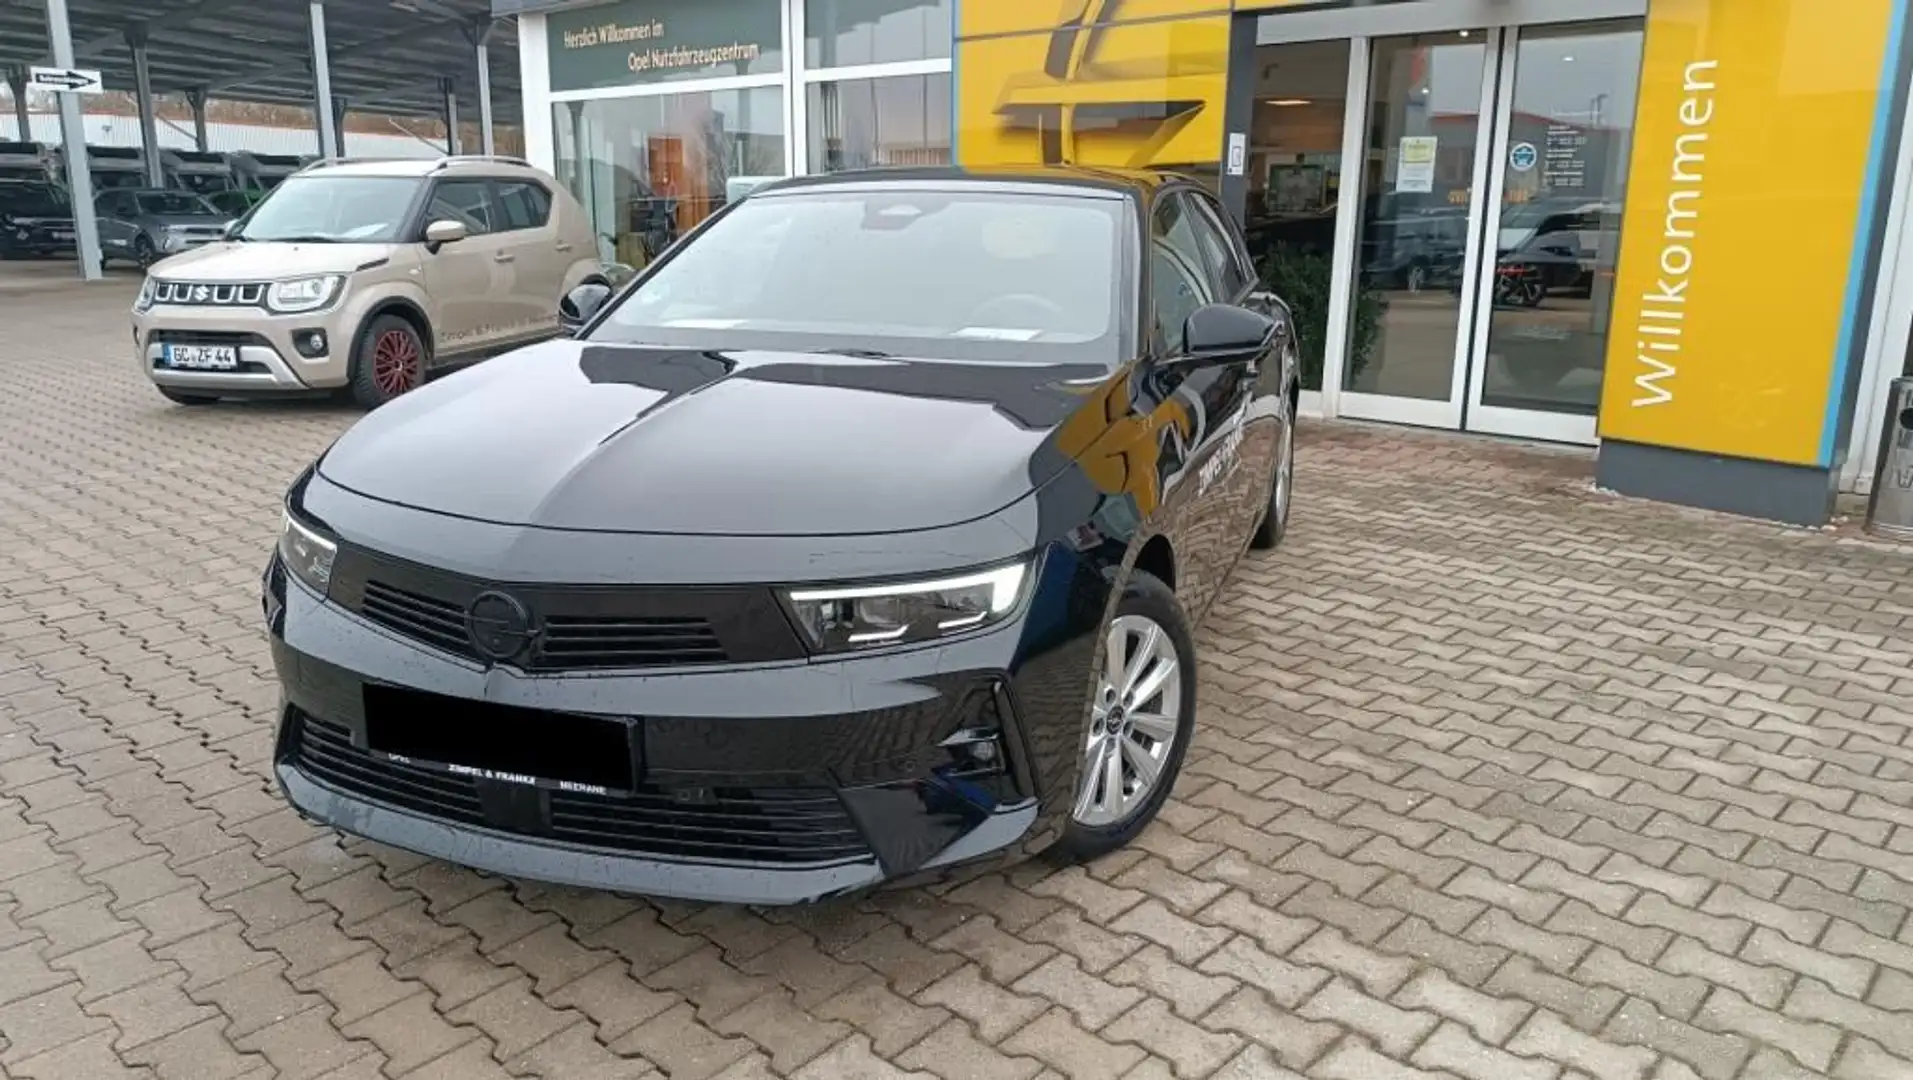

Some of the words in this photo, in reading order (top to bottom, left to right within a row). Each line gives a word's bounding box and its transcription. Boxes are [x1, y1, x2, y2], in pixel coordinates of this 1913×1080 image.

[564, 26, 598, 48] Herzlich
[598, 23, 651, 43] Willkommen
[628, 47, 650, 72] Opel
[652, 40, 759, 69] Nutzfahrzeugzentrum
[1631, 59, 1719, 408] Willkommen
